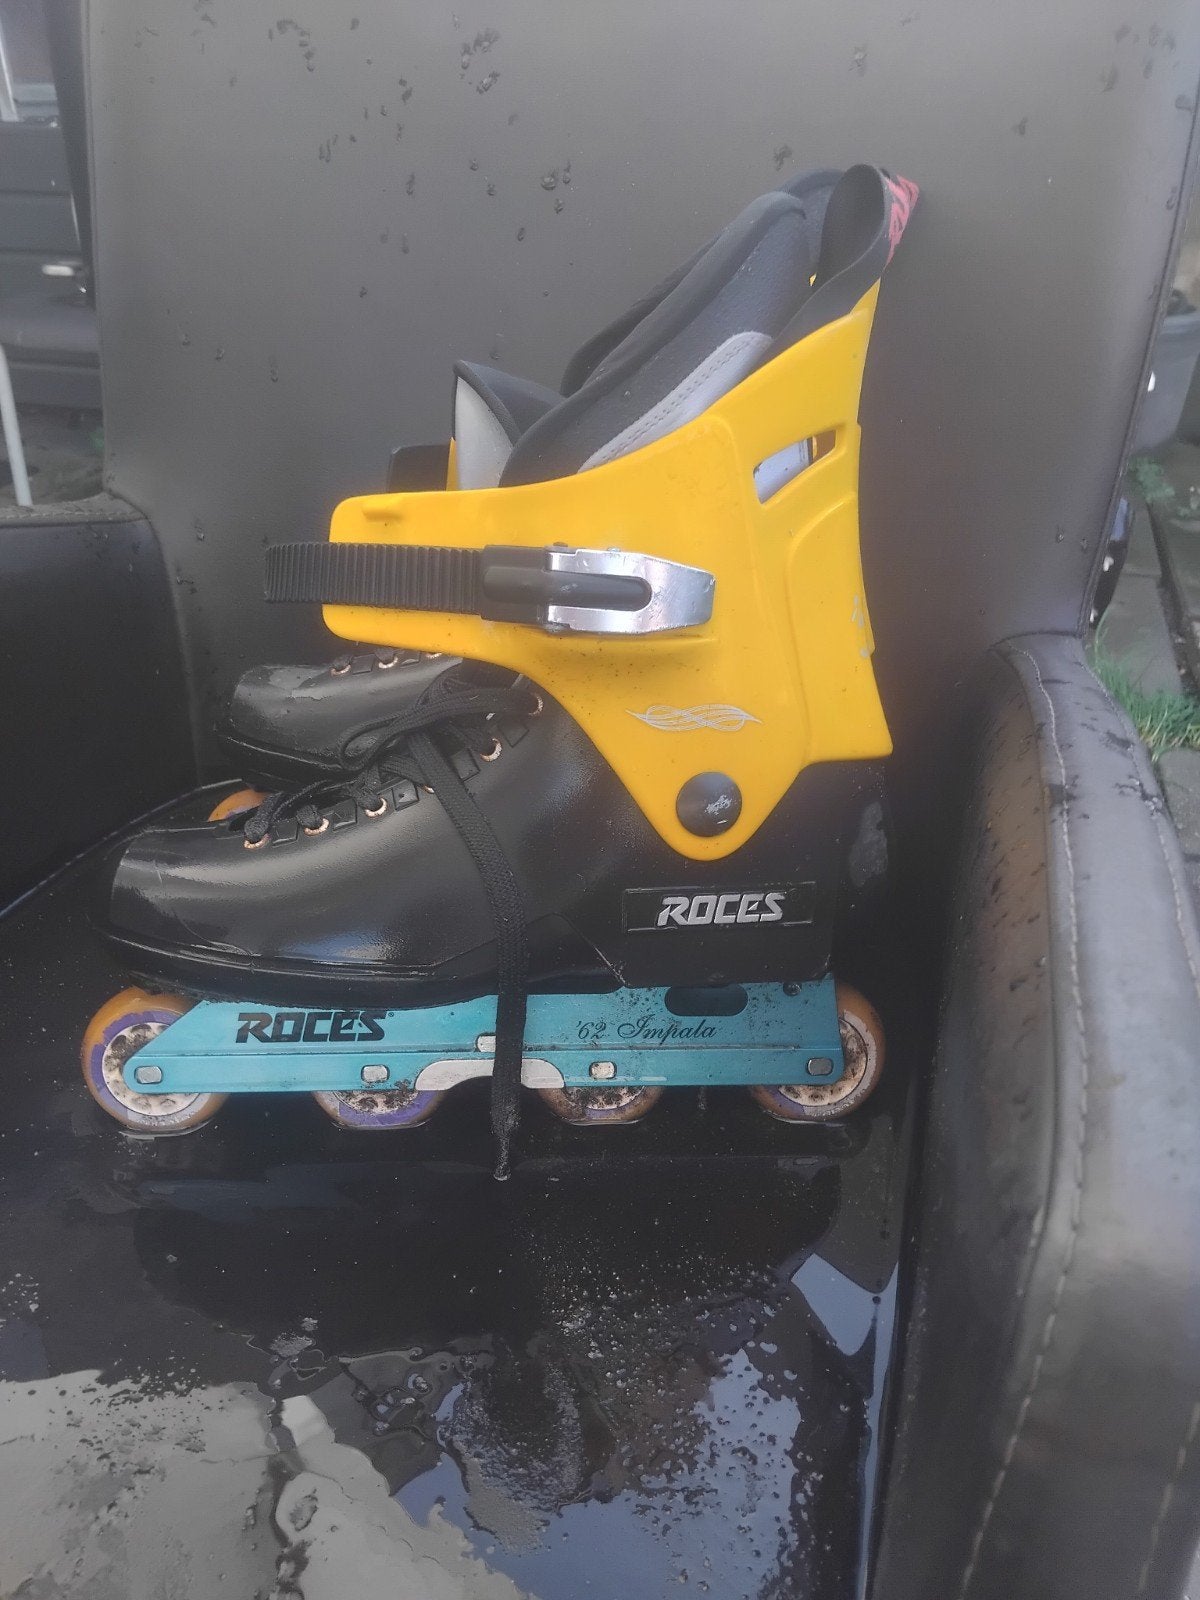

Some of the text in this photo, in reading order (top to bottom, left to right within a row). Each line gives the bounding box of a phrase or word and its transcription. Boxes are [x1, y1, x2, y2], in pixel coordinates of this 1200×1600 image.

[657, 892, 785, 926] ROCES
[235, 1011, 387, 1043] ROCES
[576, 1013, 717, 1046] '62 Impala
